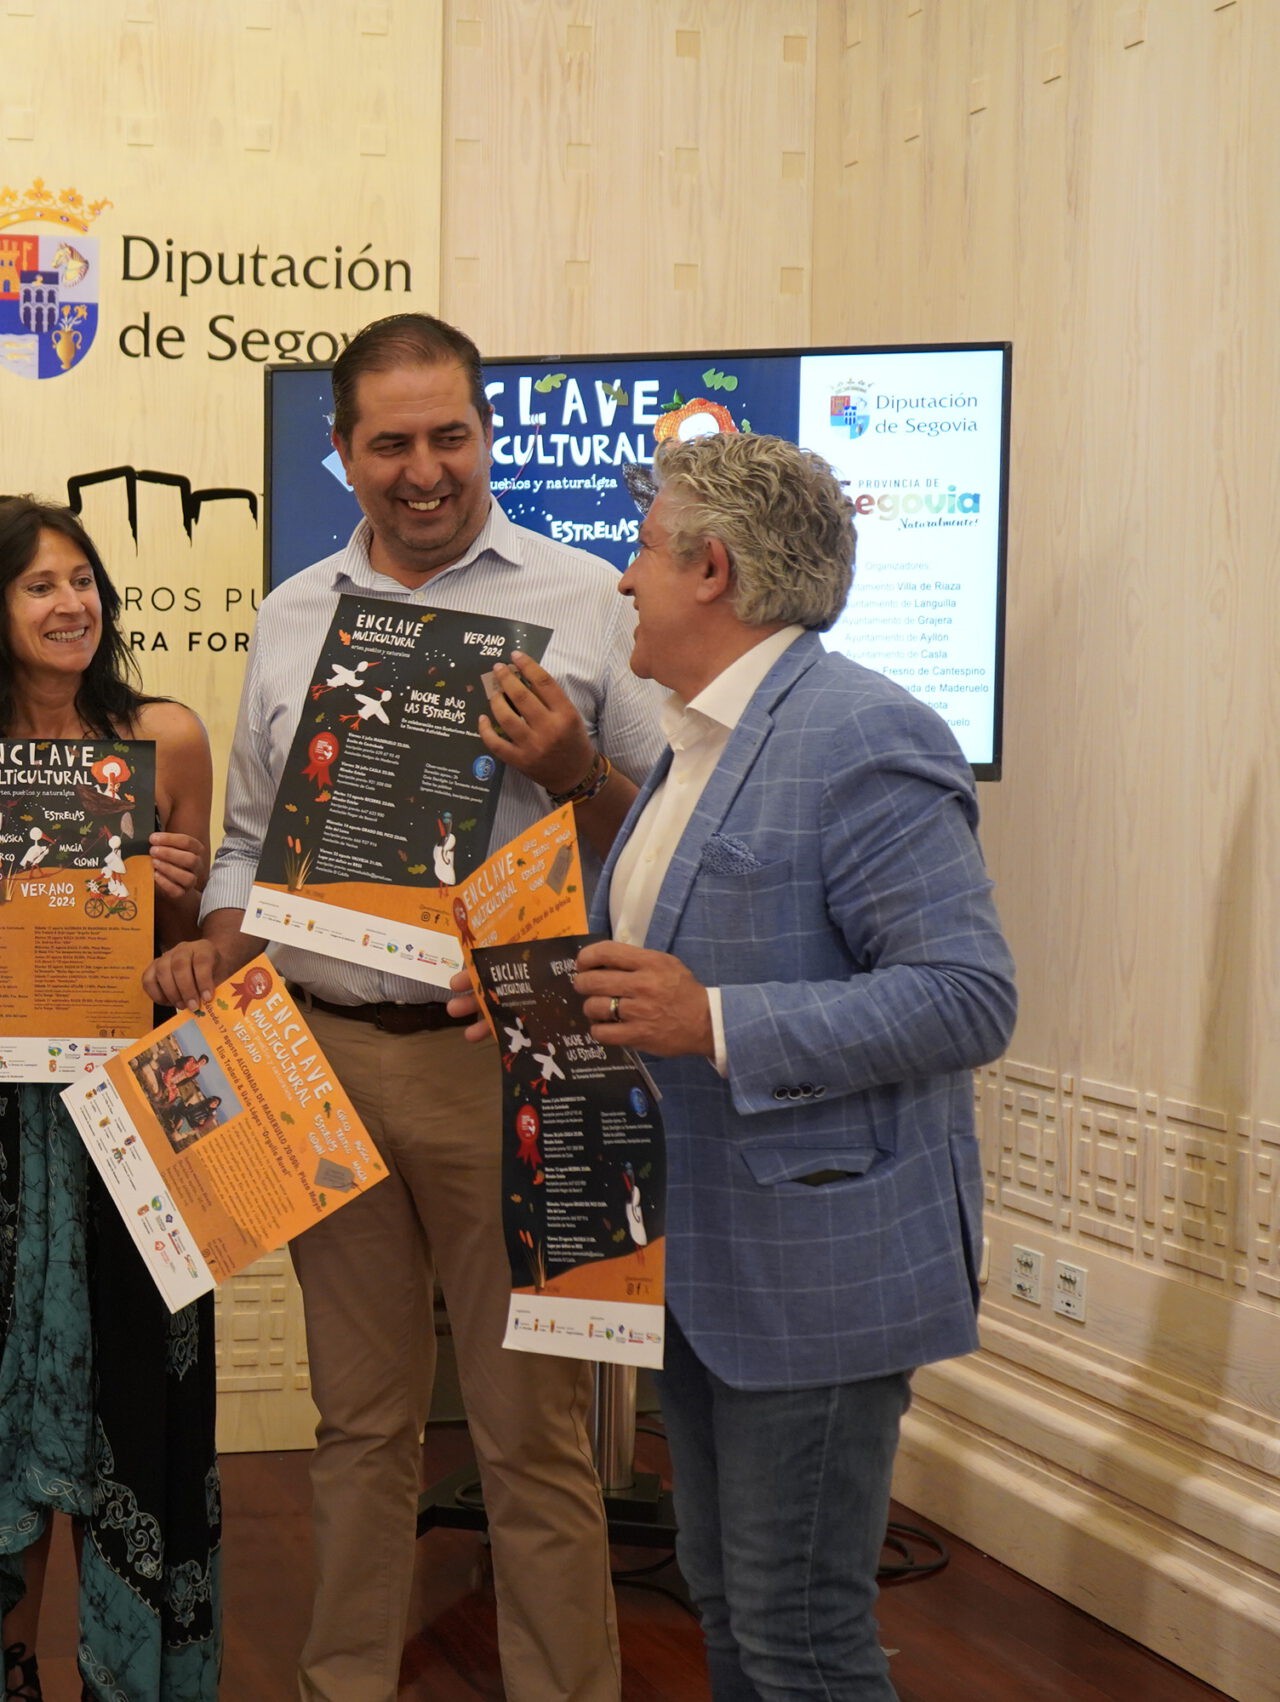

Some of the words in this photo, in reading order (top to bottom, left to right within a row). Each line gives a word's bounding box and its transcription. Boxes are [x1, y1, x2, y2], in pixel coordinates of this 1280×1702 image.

[121, 235, 413, 297] Diputación
[119, 311, 186, 359] de
[876, 392, 978, 413] Diputación
[875, 419, 898, 433] de
[905, 417, 978, 437] Segovia
[532, 478, 544, 493] y
[858, 479, 920, 489] PROVINCIA
[926, 478, 939, 488] DE
[550, 518, 640, 543] ESTRELLAS
[897, 582, 918, 591] Villa
[919, 581, 932, 591] de
[934, 581, 961, 591] Riaza
[914, 599, 957, 609] Languilla
[356, 614, 424, 638] ENCLAVE
[917, 615, 953, 627] Grajera
[463, 631, 506, 647] VERANO
[920, 631, 950, 644] Ayllón
[479, 646, 504, 658] 2024
[920, 648, 948, 659] Casla
[882, 666, 915, 676] Fresno
[917, 666, 930, 676] de
[932, 666, 986, 677] Cantespino
[924, 683, 937, 692] de
[939, 683, 989, 692] Maderuelo
[410, 689, 441, 706] NOCHE
[444, 696, 466, 710] BAJO
[404, 702, 420, 714] LAS
[422, 704, 467, 724] ESTRELLAS
[44, 810, 86, 822] ESTRELLAS
[74, 857, 99, 868] CLOWN
[462, 852, 516, 911] ENCLAVE
[20, 882, 75, 897] VERANO
[48, 895, 76, 908] 2024
[490, 962, 530, 982] ENCLAVE
[232, 1021, 263, 1064] VERANO
[265, 992, 333, 1100] ENCLAVE
[236, 1057, 260, 1096] ALCONADA
[262, 1103, 288, 1146] MADERUELO
